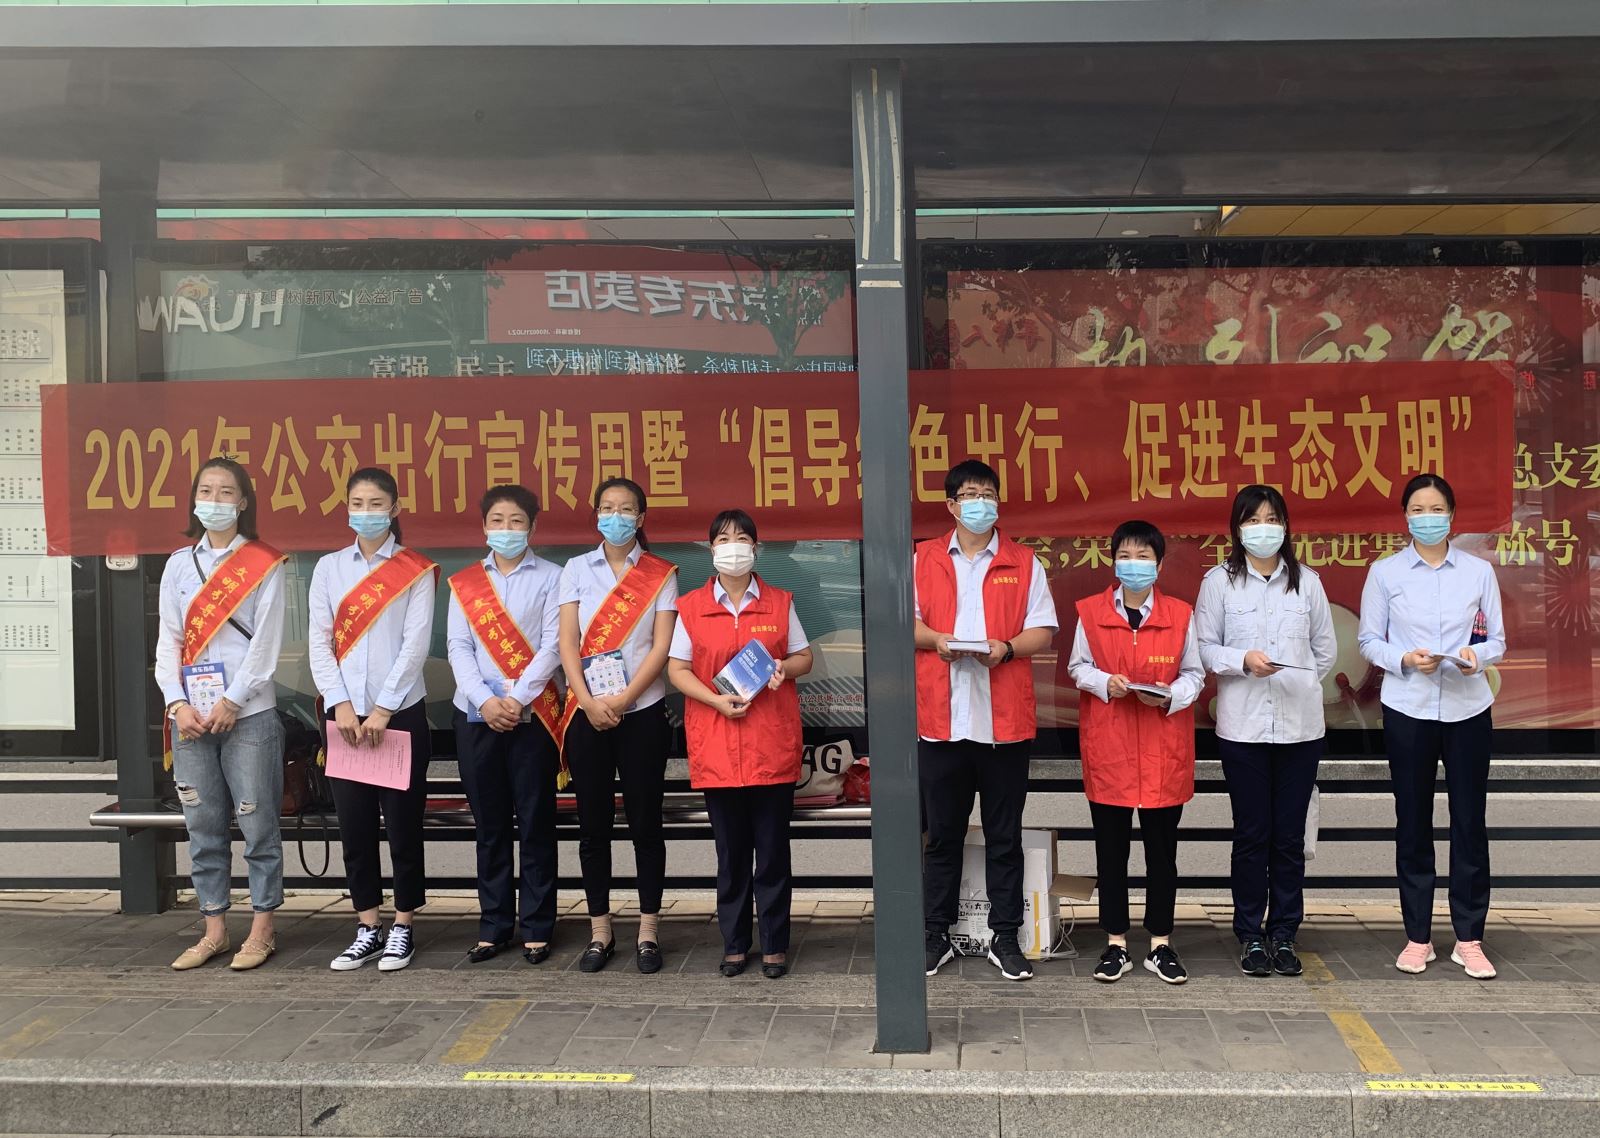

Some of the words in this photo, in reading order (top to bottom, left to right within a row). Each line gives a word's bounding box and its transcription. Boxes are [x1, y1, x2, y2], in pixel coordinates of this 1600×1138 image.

[84, 395, 1473, 517] 2021年公交出行宣传周暨“倡导色出行、促进生态文明”
